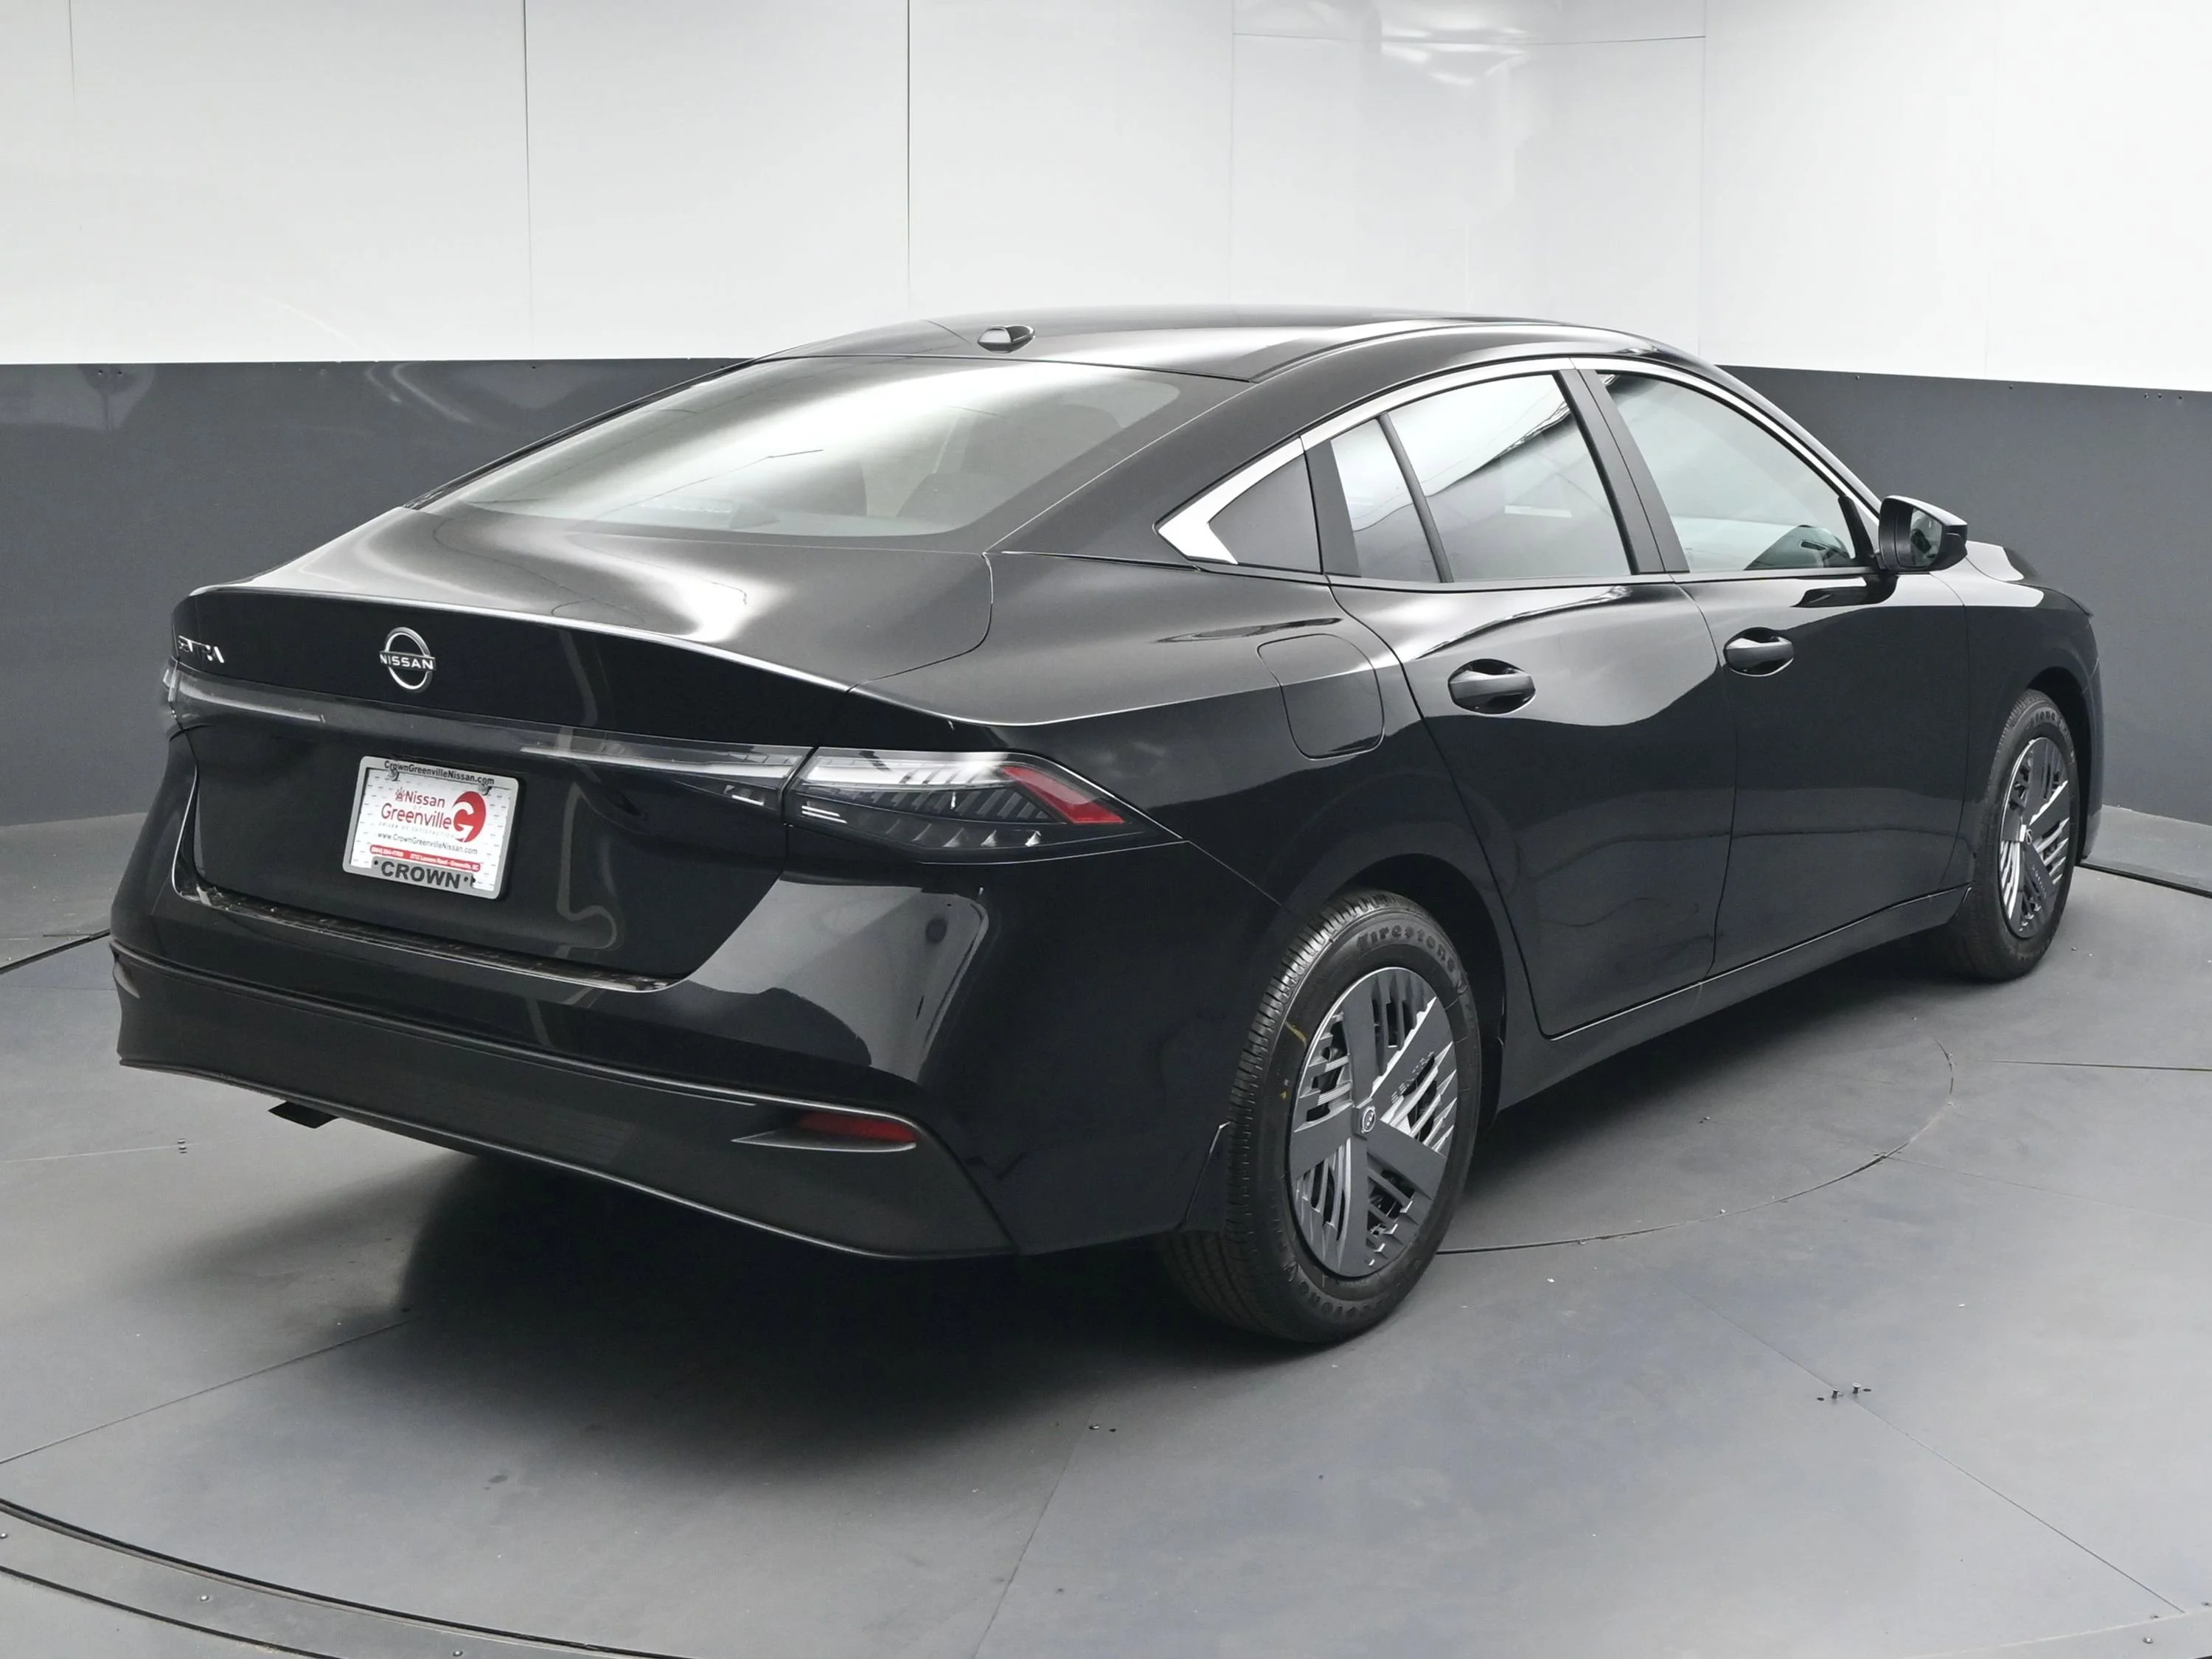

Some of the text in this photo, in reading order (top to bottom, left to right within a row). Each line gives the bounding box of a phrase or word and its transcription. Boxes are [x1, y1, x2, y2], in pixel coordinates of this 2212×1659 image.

[379, 653, 434, 669] NISSAN
[384, 760, 495, 785] CrownGreenvilleNissan.com
[405, 790, 445, 808] Nissan
[380, 802, 452, 830] Greenville
[380, 860, 461, 889] CROWN
